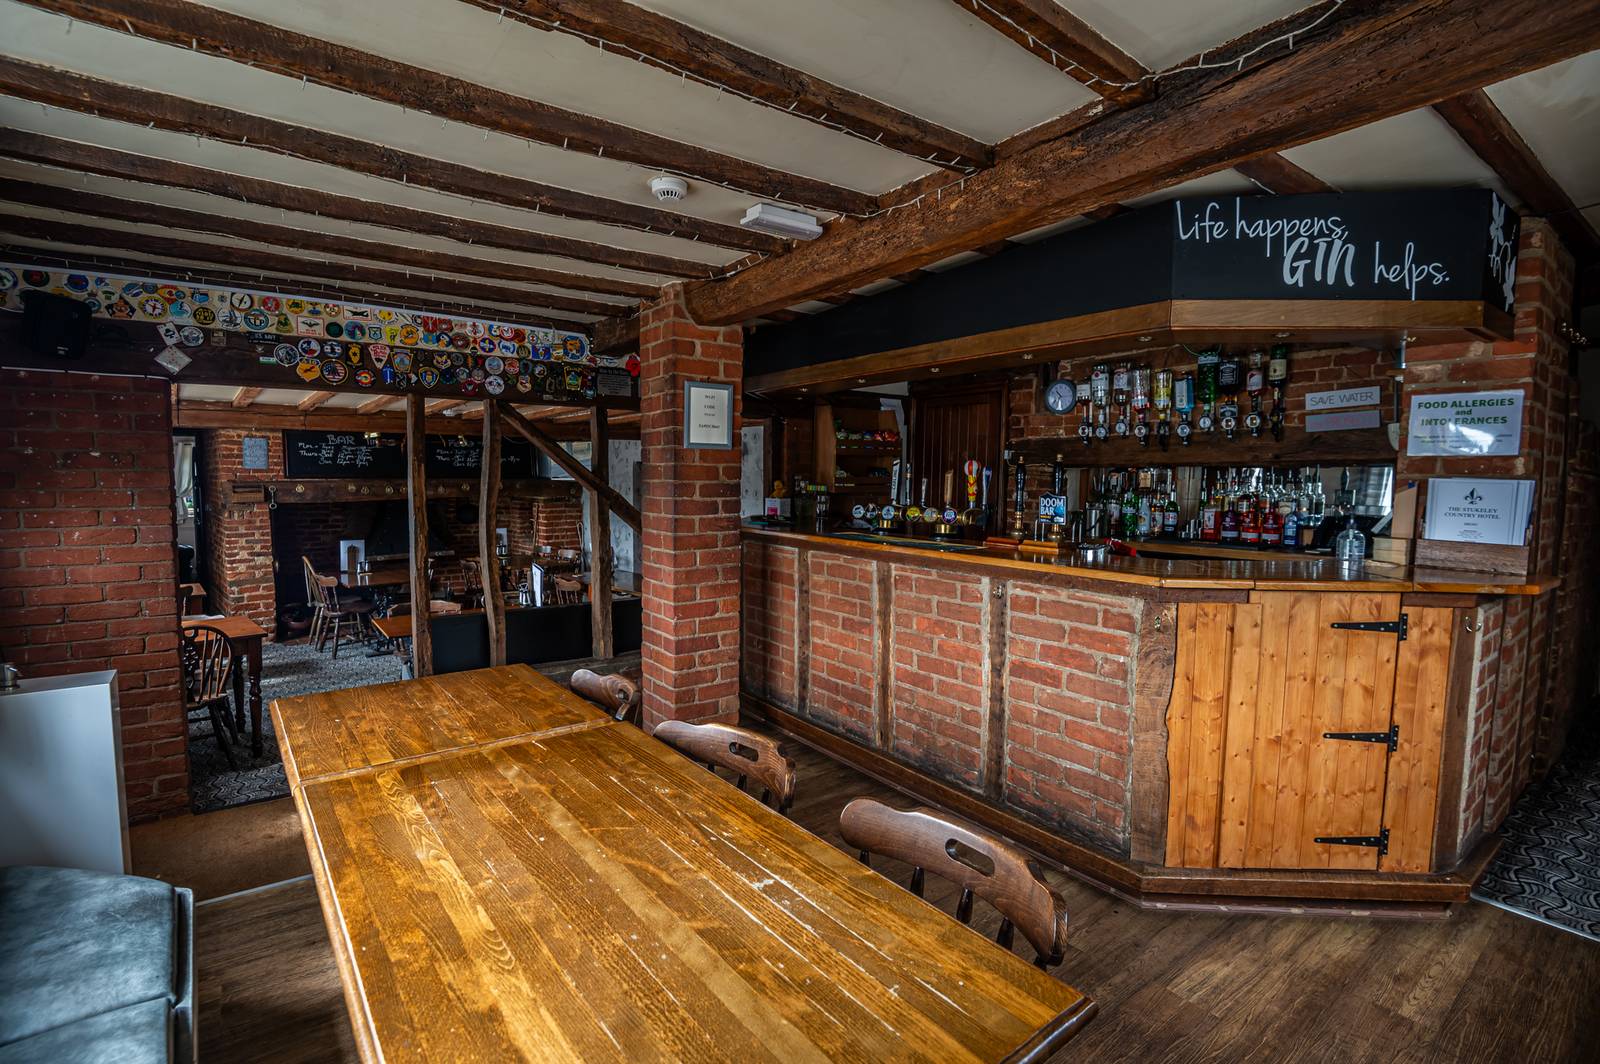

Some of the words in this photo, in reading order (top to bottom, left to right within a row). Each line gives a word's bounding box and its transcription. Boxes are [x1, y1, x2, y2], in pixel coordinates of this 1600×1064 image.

[1175, 200, 1228, 244] Life
[1236, 197, 1349, 258] happens,
[1373, 240, 1450, 300] helps.
[1310, 394, 1335, 407] SAVE
[1338, 391, 1375, 404] WATER
[1417, 400, 1449, 410] FOOD
[1450, 397, 1515, 409] ALLERGIES
[1454, 408, 1473, 416] and
[326, 433, 356, 446] BAR
[1041, 498, 1064, 507] DOOM
[1041, 506, 1055, 516] BAR
